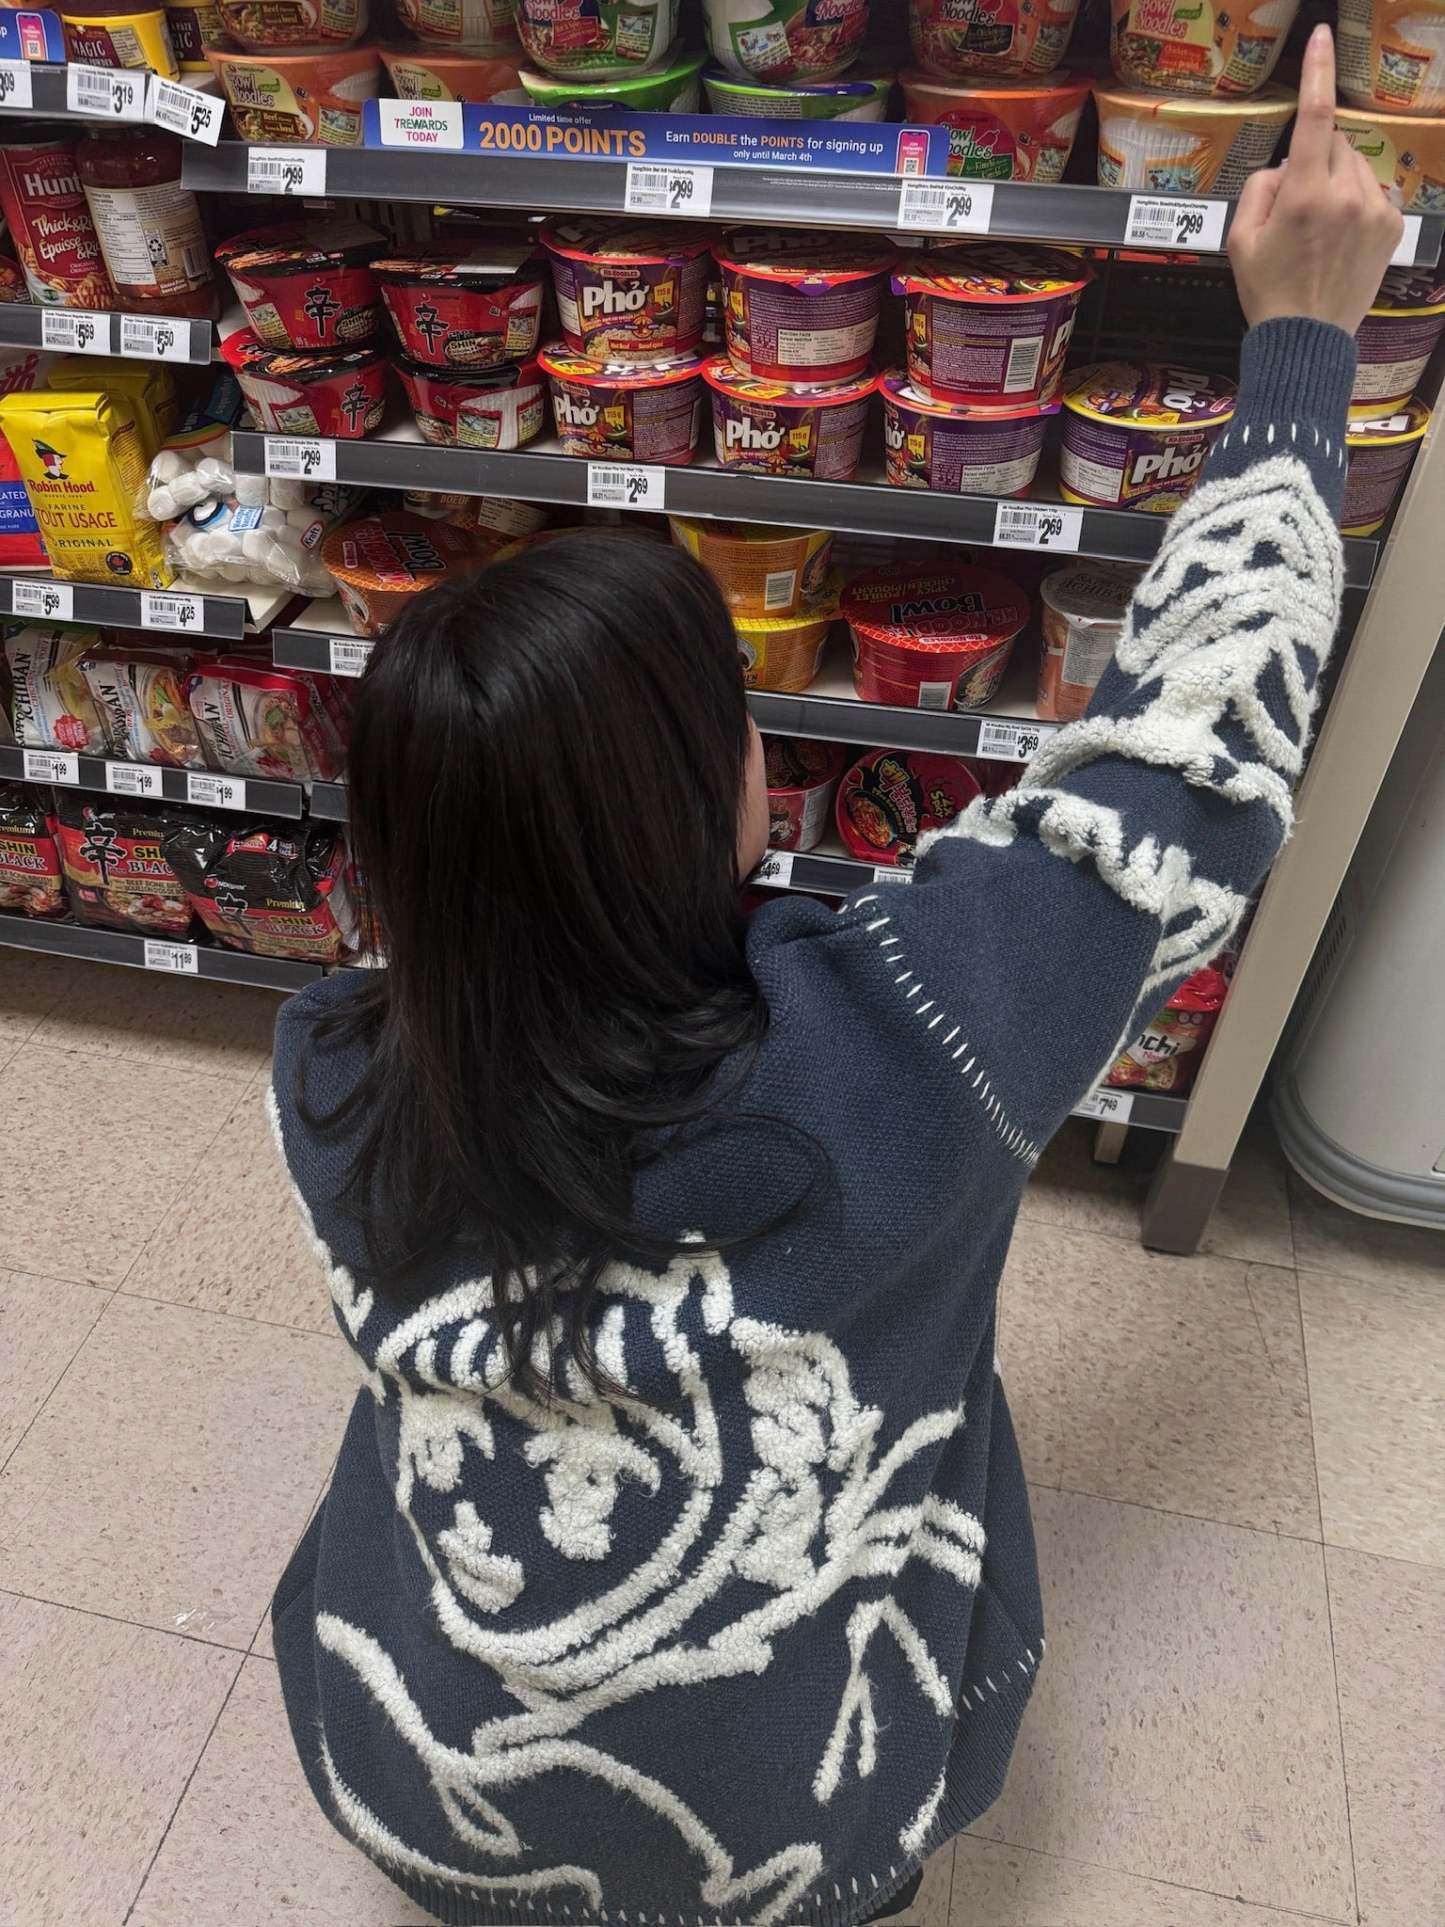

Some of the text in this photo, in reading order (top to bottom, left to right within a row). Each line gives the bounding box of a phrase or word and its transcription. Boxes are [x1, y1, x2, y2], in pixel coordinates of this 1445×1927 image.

[71, 39, 106, 57] MAGIC
[409, 106, 433, 118] JOIN
[529, 113, 592, 125] Limited time offer
[394, 118, 448, 131] 7REWARDS
[405, 131, 439, 142] TODAY
[479, 121, 647, 157] 2000 POINTS
[666, 131, 884, 154] Earn DOUBLE the POINTS for signing up
[733, 150, 813, 162] only until March 4th
[23, 171, 83, 196] Hunt
[304, 285, 340, 338] 辛
[415, 303, 449, 356] 辛
[450, 340, 478, 350] SHIN
[884, 420, 905, 450] hở
[28, 479, 96, 493] Robin Hood
[0, 491, 27, 500] ATED
[0, 508, 34, 519] GRANU
[34, 507, 118, 529] TOUT USAGE
[304, 526, 321, 546] Kraft
[891, 592, 983, 624] Bowl
[132, 828, 164, 838] Premiu
[134, 846, 165, 860] SH
[129, 860, 175, 876] BLAC
[1138, 1034, 1180, 1056] chi
